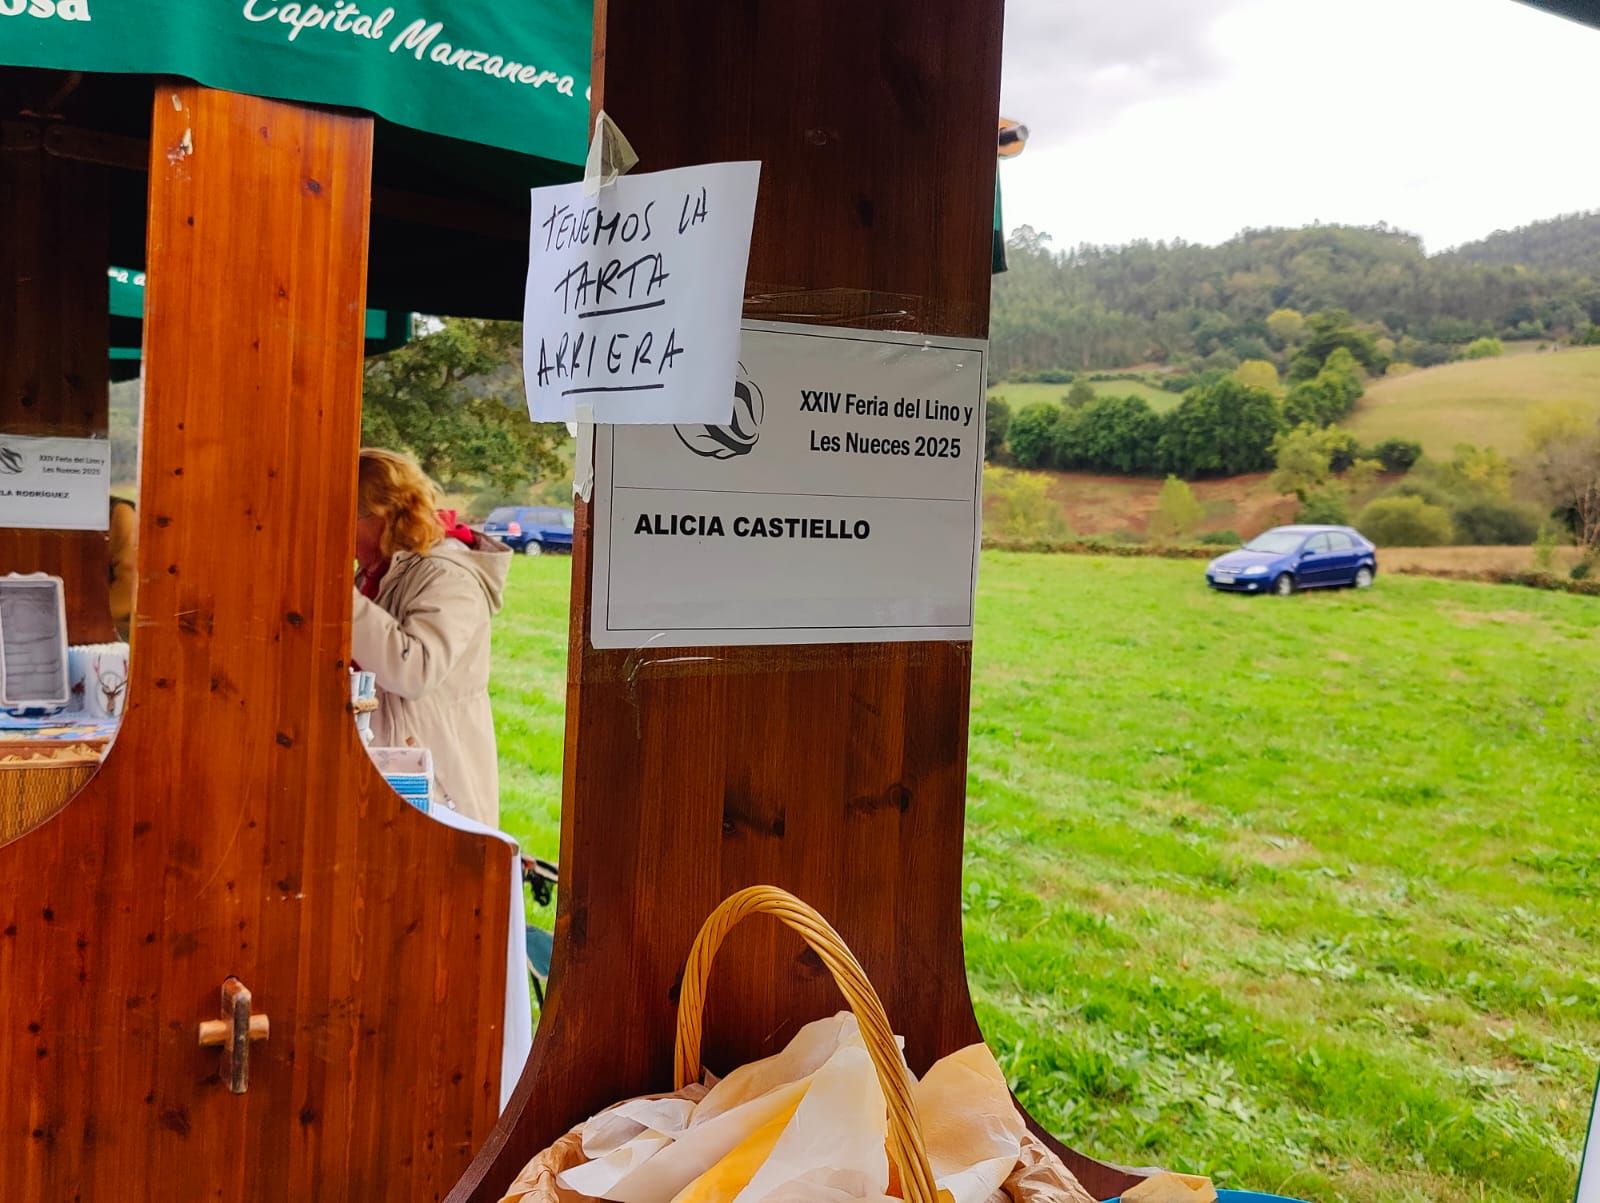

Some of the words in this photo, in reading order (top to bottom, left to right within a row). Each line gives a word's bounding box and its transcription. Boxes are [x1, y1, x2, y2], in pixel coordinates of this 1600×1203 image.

[243, 0, 395, 41] Capital
[389, 18, 574, 96] Manzanera
[543, 200, 655, 251] TENEMOS
[678, 186, 708, 234] LA
[554, 252, 669, 314] TARTA
[537, 328, 684, 387] ARRIERA
[800, 390, 841, 414] XXIV
[845, 393, 888, 417] Feria
[894, 398, 921, 419] del
[925, 399, 960, 421] Lino
[963, 405, 973, 427] y
[810, 430, 841, 452] Les
[845, 432, 910, 456] Nueces
[914, 436, 961, 459] 2025
[634, 514, 725, 536] ALICIA
[733, 516, 871, 540] CASTIELLO
